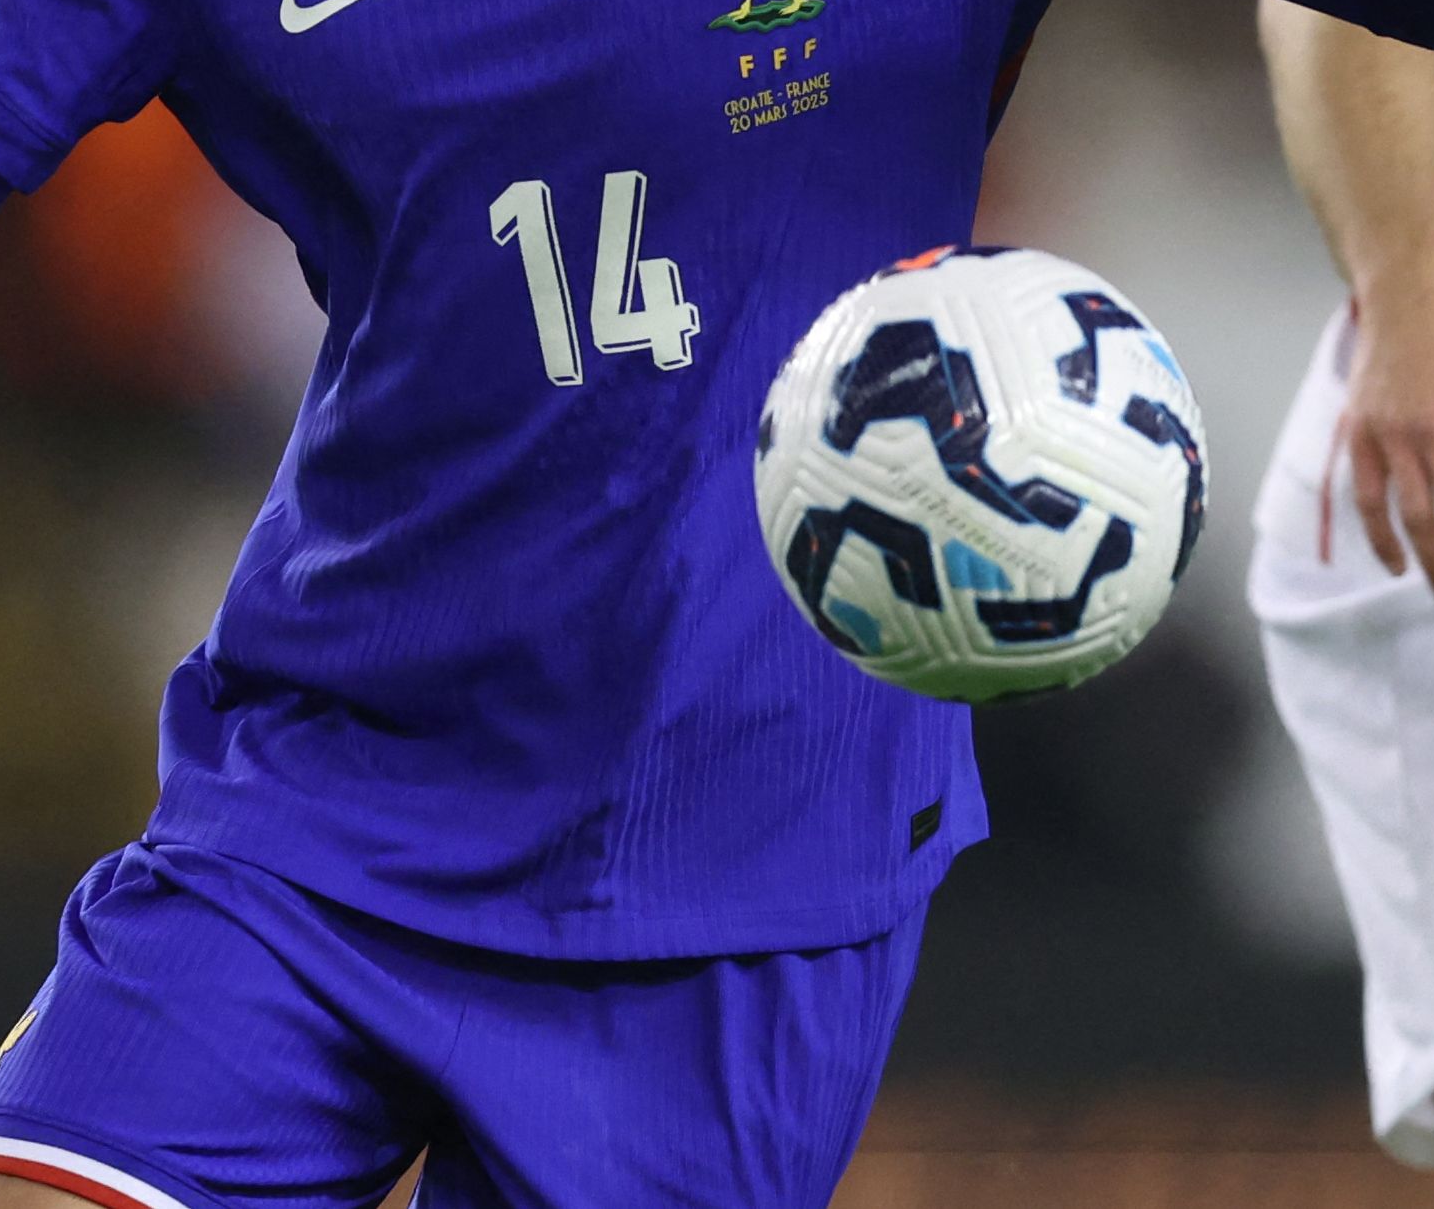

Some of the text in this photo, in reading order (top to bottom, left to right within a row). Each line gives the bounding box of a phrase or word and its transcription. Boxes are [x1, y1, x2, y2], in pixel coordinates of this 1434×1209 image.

[724, 90, 774, 117] CROATIE
[786, 72, 831, 99] FRANCE
[730, 90, 829, 135] 20 MARS 2025
[489, 170, 701, 387] 14
